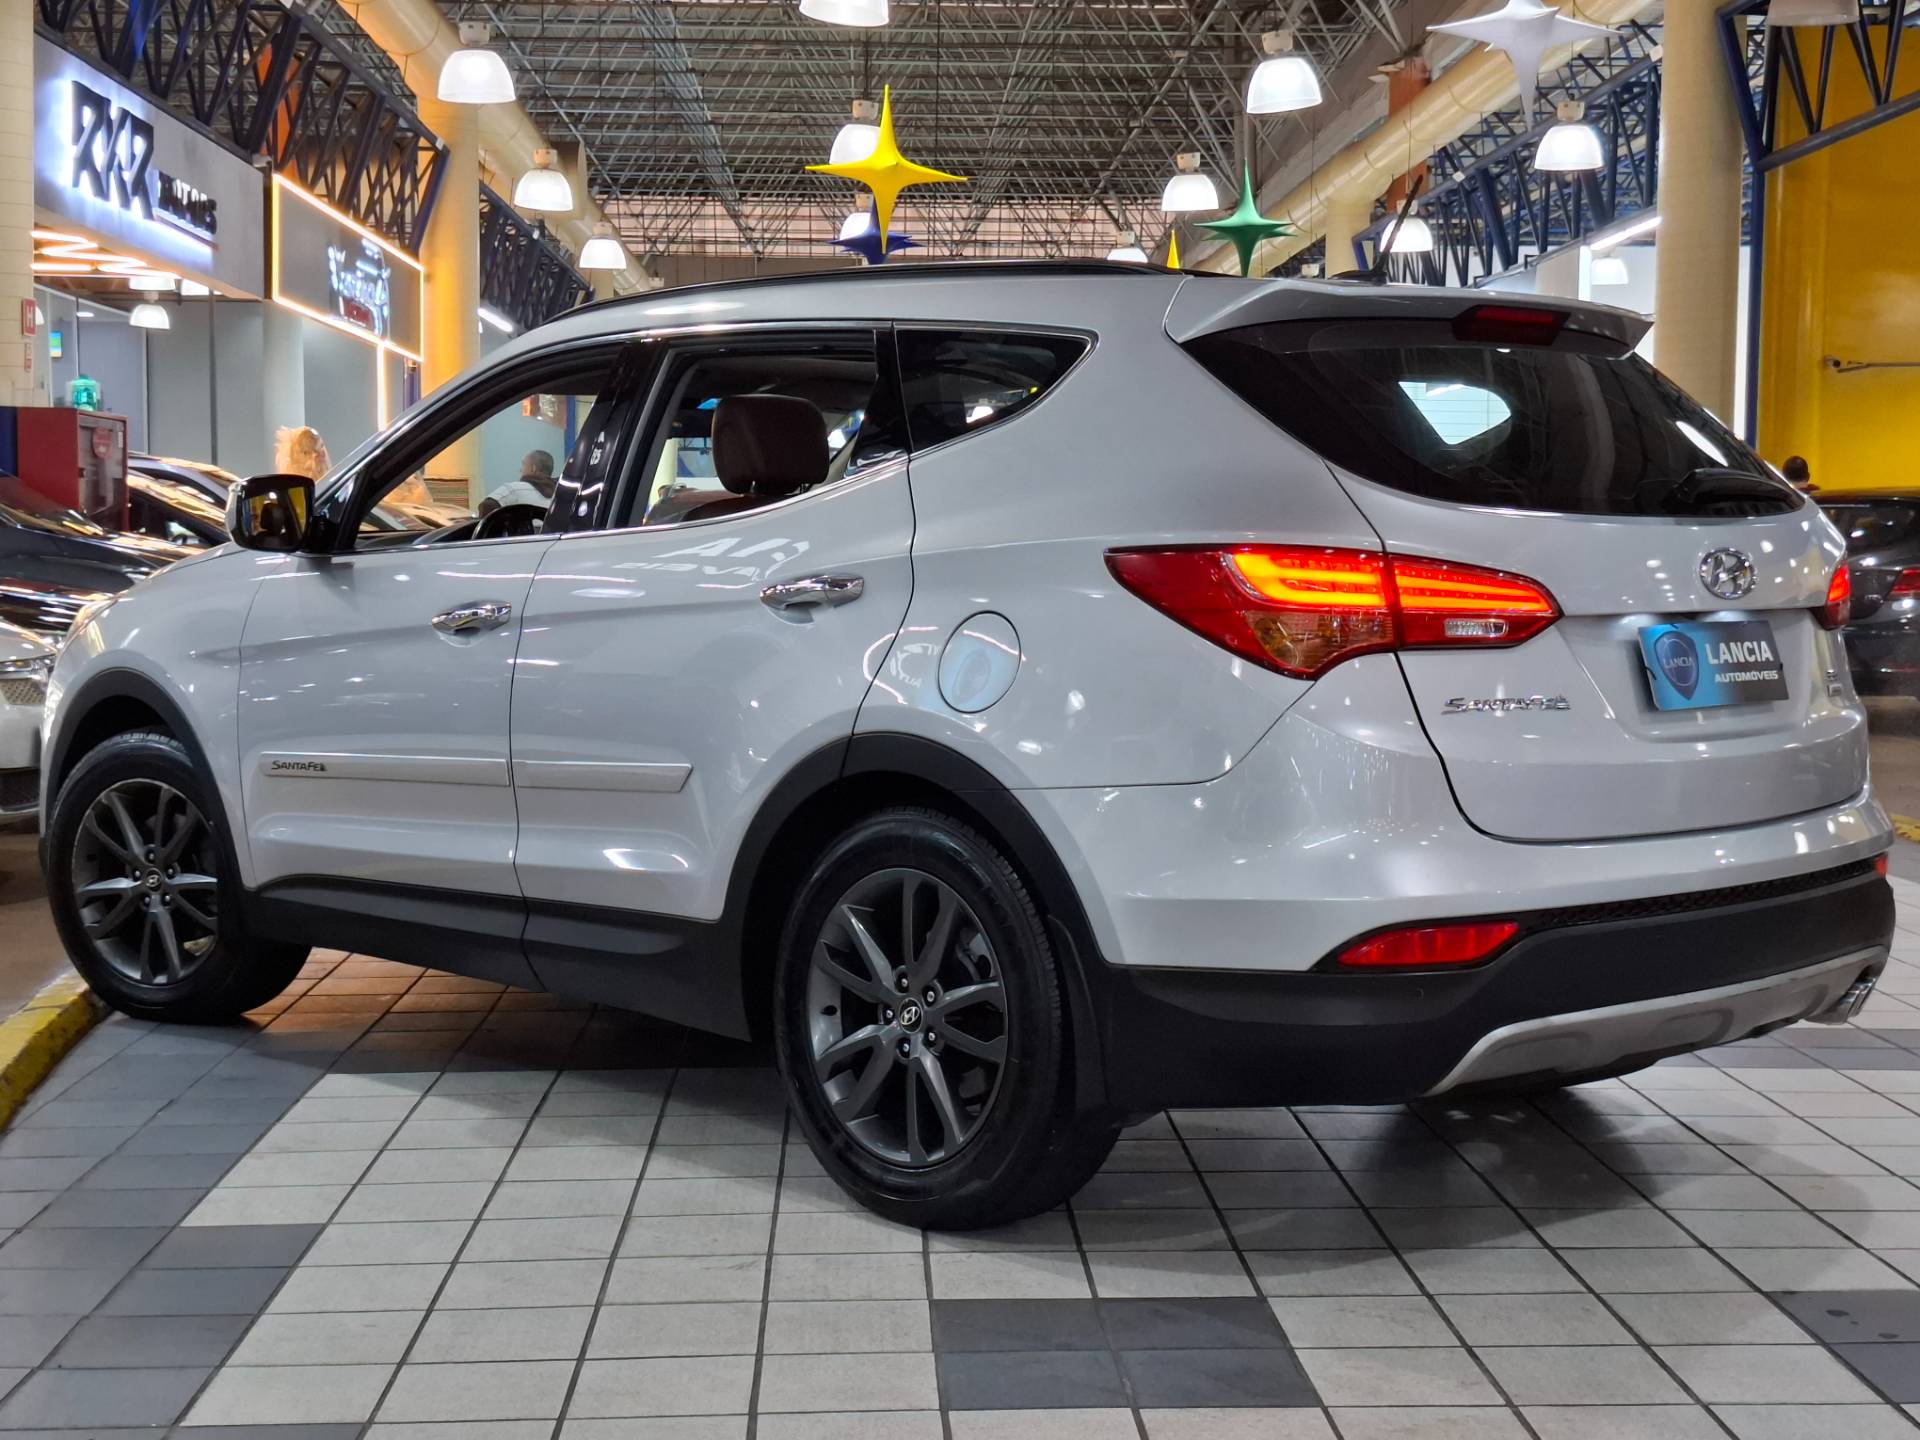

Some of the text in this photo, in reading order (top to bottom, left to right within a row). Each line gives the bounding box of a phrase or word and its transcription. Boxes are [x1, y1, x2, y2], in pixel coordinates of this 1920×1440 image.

[1705, 640, 1774, 665] LANCIA
[1663, 656, 1695, 669] LANCIA
[1714, 670, 1779, 684] AUTOMÓVEIS
